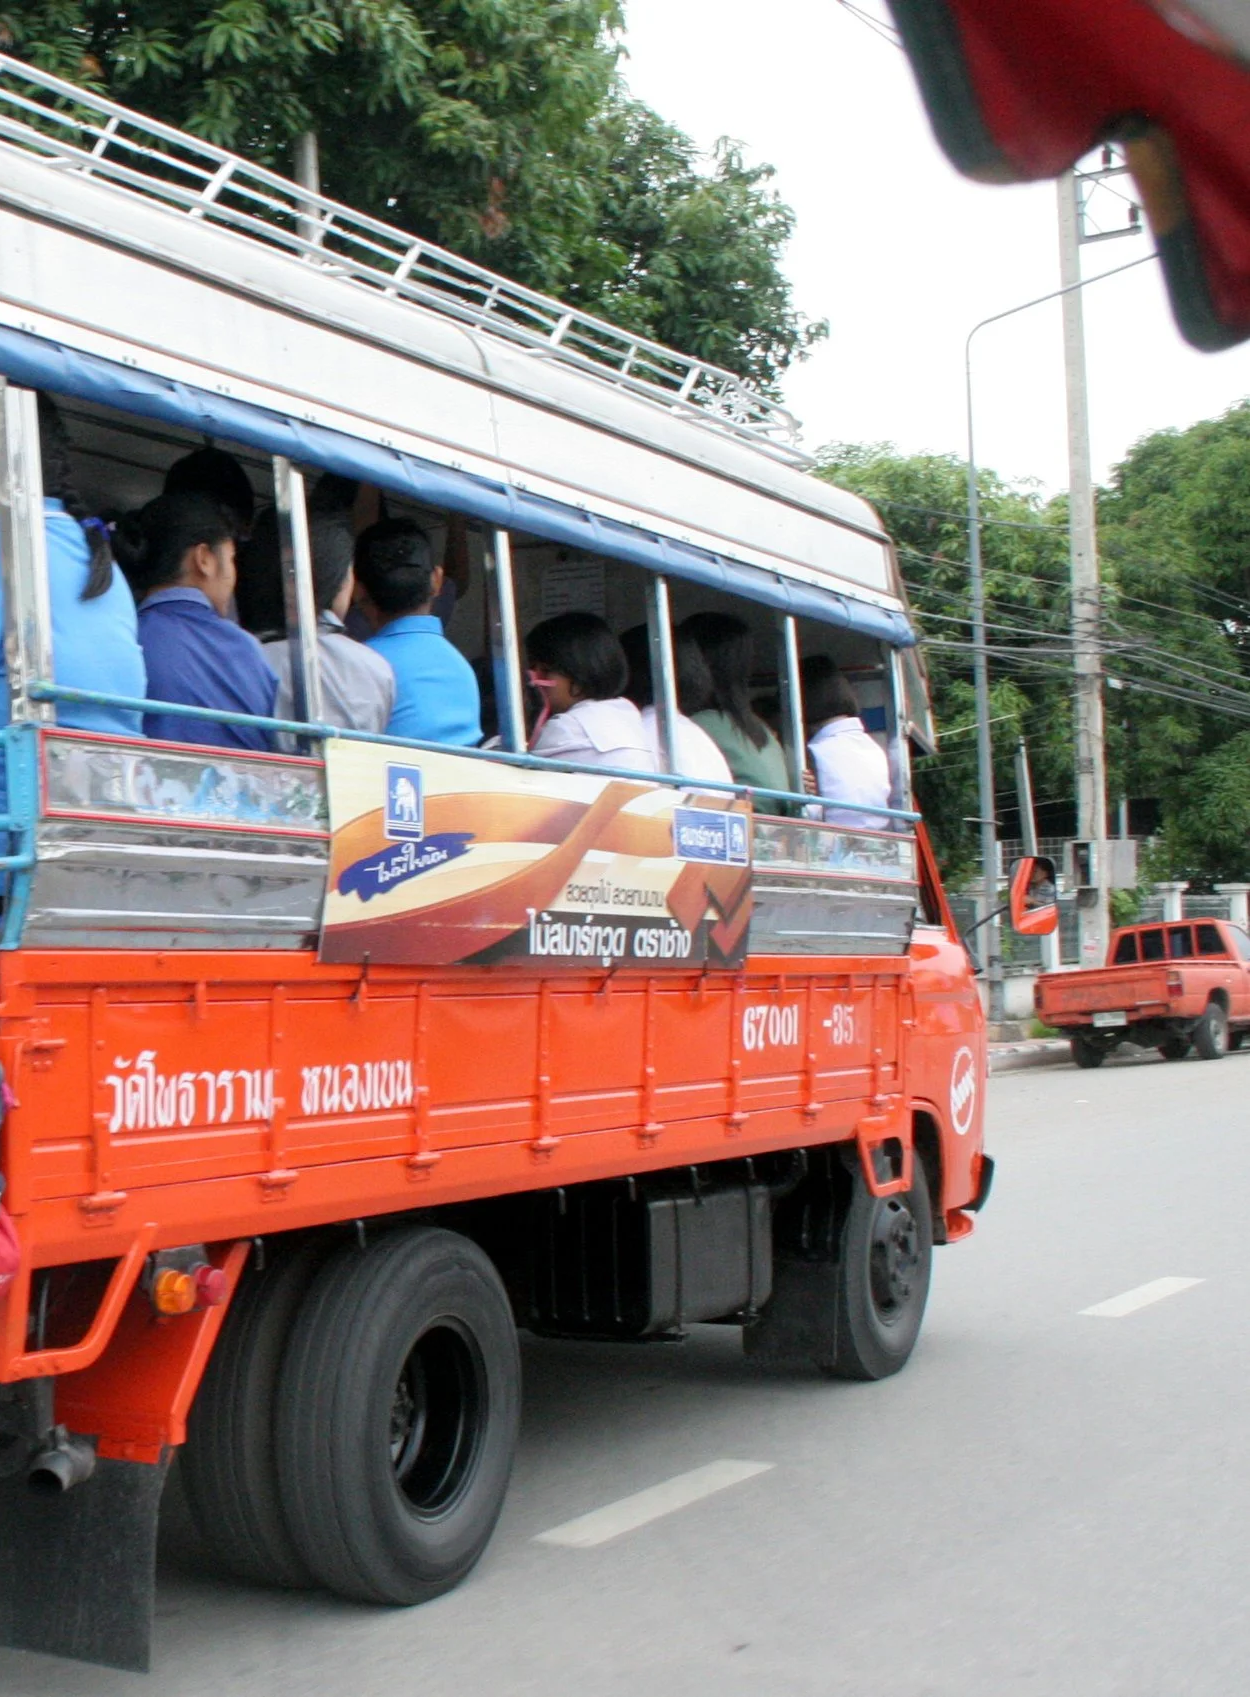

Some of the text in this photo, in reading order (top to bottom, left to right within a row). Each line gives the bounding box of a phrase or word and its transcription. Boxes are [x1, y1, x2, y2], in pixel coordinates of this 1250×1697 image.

[526, 907, 692, 967] ไม้สมาร์ทวูด ตราช้าง
[104, 1050, 414, 1133] วัดโพธาราม หนองเบน
